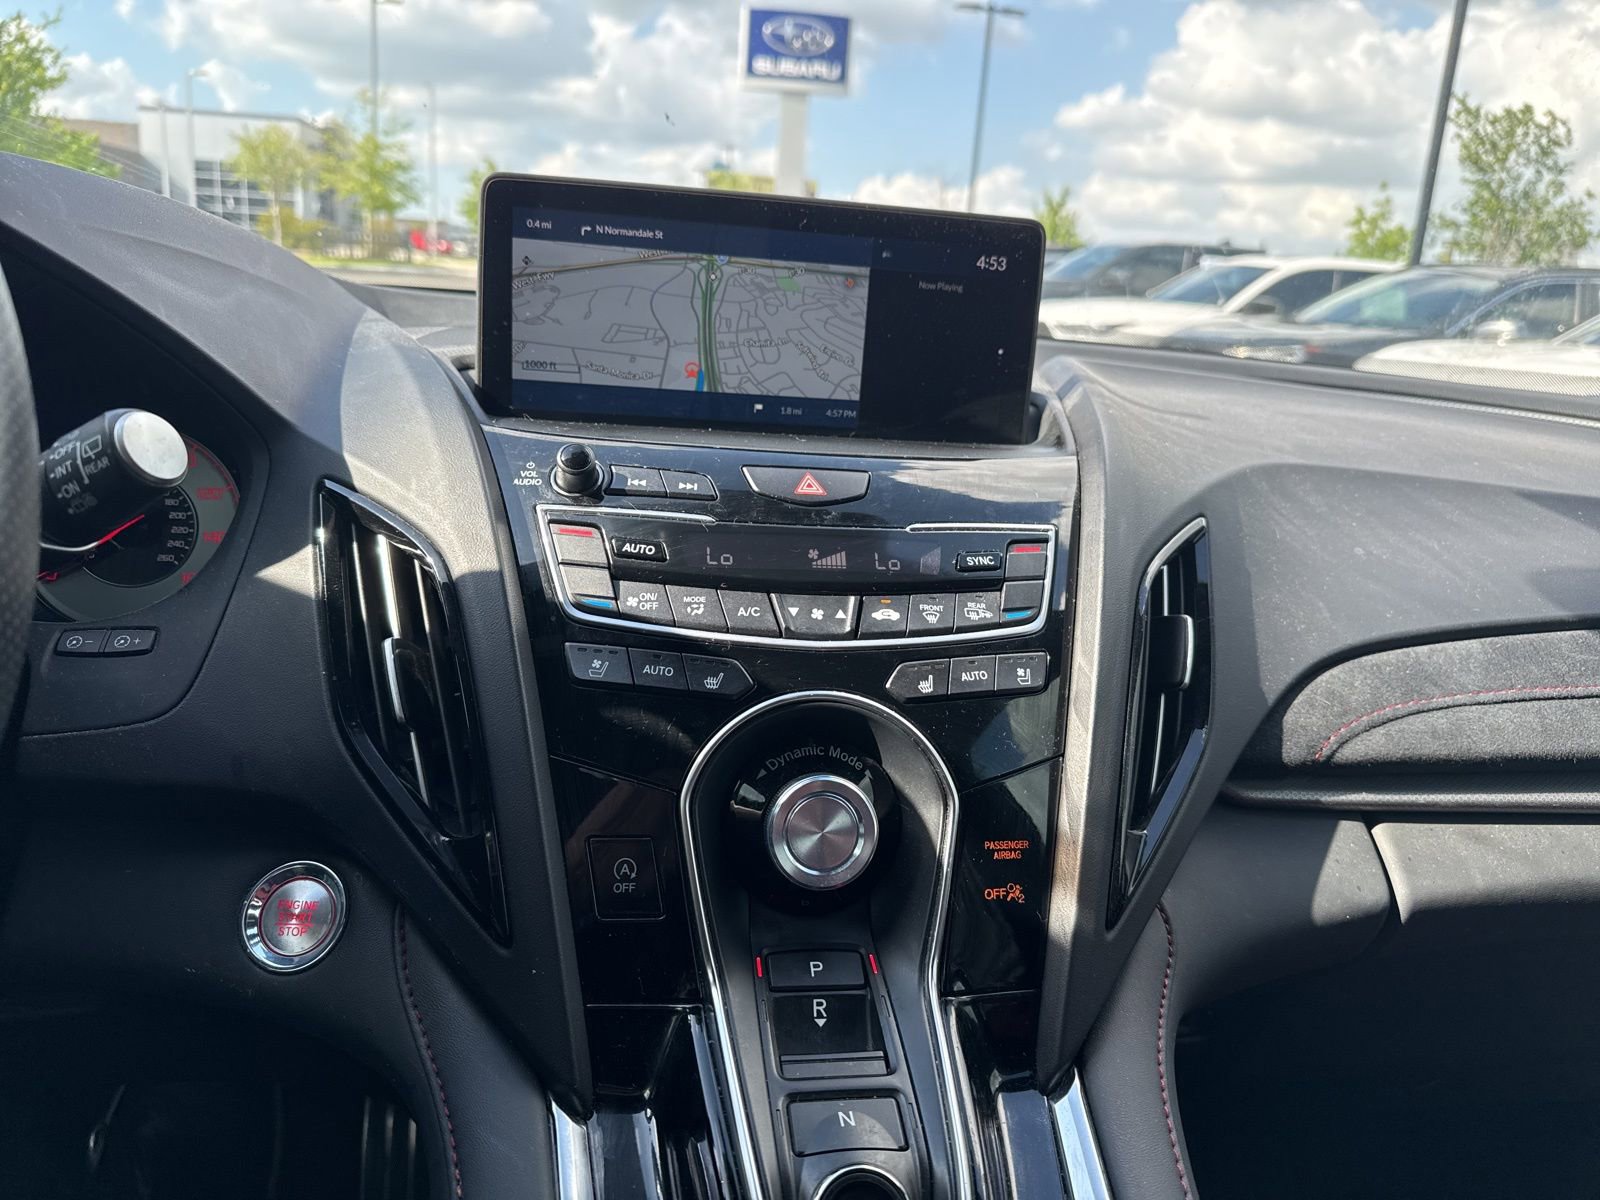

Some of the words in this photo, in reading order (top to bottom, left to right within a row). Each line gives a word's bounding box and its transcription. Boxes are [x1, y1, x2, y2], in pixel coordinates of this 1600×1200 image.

[526, 219, 540, 229] 0.4
[541, 220, 552, 230] mi
[595, 224, 604, 235] N
[604, 226, 655, 240] Normandale
[655, 231, 664, 240] St
[976, 255, 1008, 272] 4:53
[918, 280, 937, 291] Now
[937, 282, 964, 294] Playing
[525, 359, 548, 370] 1000
[549, 361, 558, 371] ft
[781, 406, 792, 416] 1.8
[792, 408, 802, 416] mi
[55, 441, 77, 460] OFF
[55, 460, 73, 479] INT
[85, 456, 110, 475] REAR
[519, 470, 538, 478] VOL
[512, 477, 543, 486] AUDIO
[61, 480, 81, 499] ON
[621, 543, 656, 556] AUTO
[706, 546, 733, 566] Lo
[874, 551, 901, 571] Lo
[966, 555, 995, 567] SYNC
[639, 592, 658, 602] ON/
[683, 595, 706, 604] MODE
[639, 601, 659, 611] OFF
[737, 606, 761, 617] A/C
[919, 603, 944, 613] FRONT
[967, 601, 987, 610] REAR
[643, 663, 674, 678] AUTO
[961, 669, 988, 683] AUTO
[765, 744, 826, 771] Dynamic
[828, 745, 864, 771] Mode
[984, 840, 1029, 850] PASSENGER
[993, 850, 1022, 860] AIRBAG
[613, 882, 637, 894] OFF
[984, 887, 1007, 900] OFF
[276, 899, 320, 911] ENGINE
[277, 926, 309, 937] STOP
[809, 960, 824, 978] P
[813, 998, 827, 1018] R
[837, 1110, 857, 1127] N
